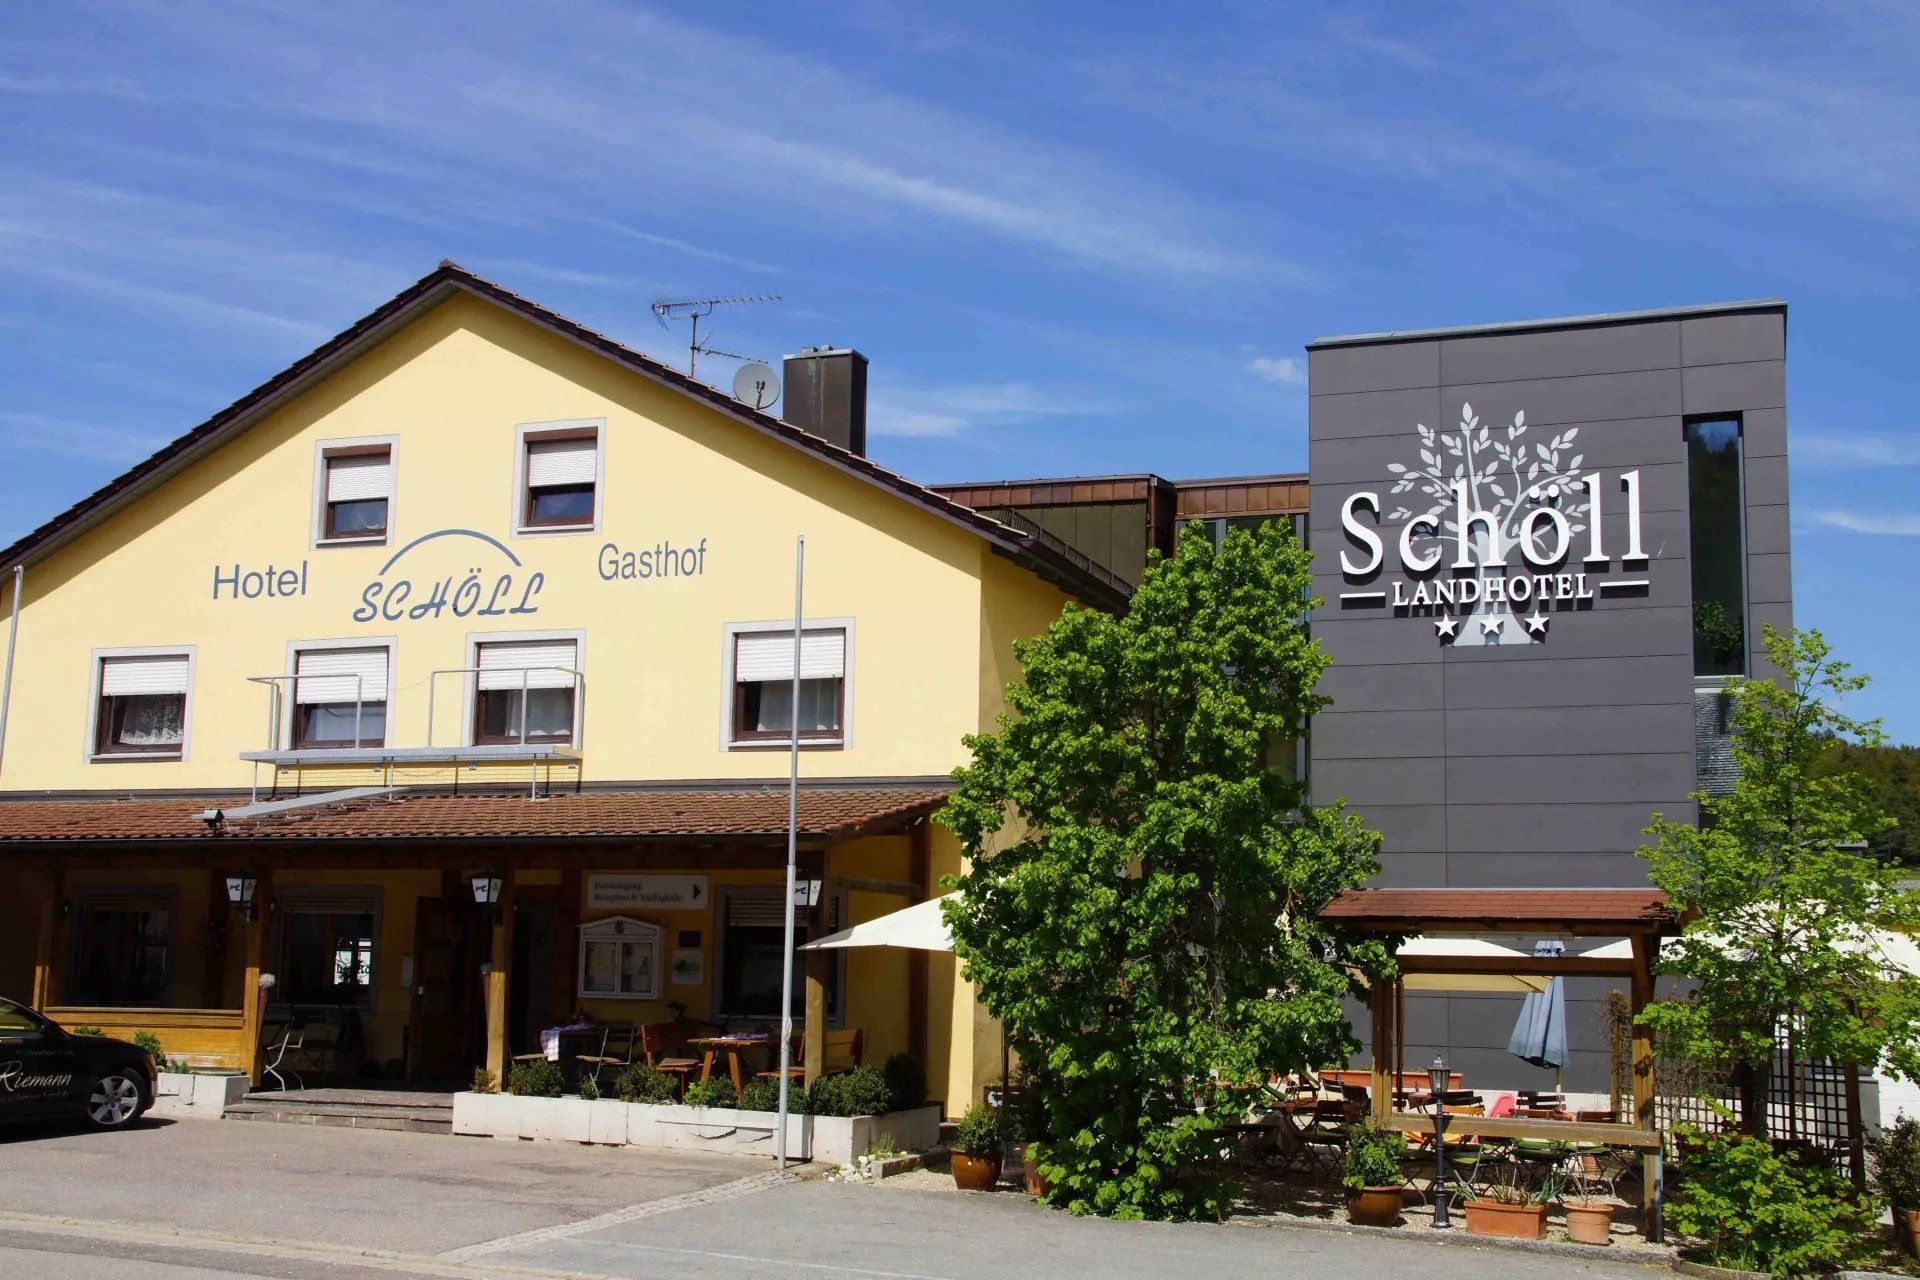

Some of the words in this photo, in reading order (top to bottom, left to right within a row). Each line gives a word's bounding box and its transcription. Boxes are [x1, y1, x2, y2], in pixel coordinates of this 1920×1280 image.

[1339, 470, 1649, 575] Schöll
[213, 560, 308, 600] Hotel
[600, 538, 707, 581] Gasthof
[353, 567, 545, 622] SCHÖLL
[1392, 574, 1593, 606] LANDHOTEL
[0, 1060, 72, 1092] Riemann
